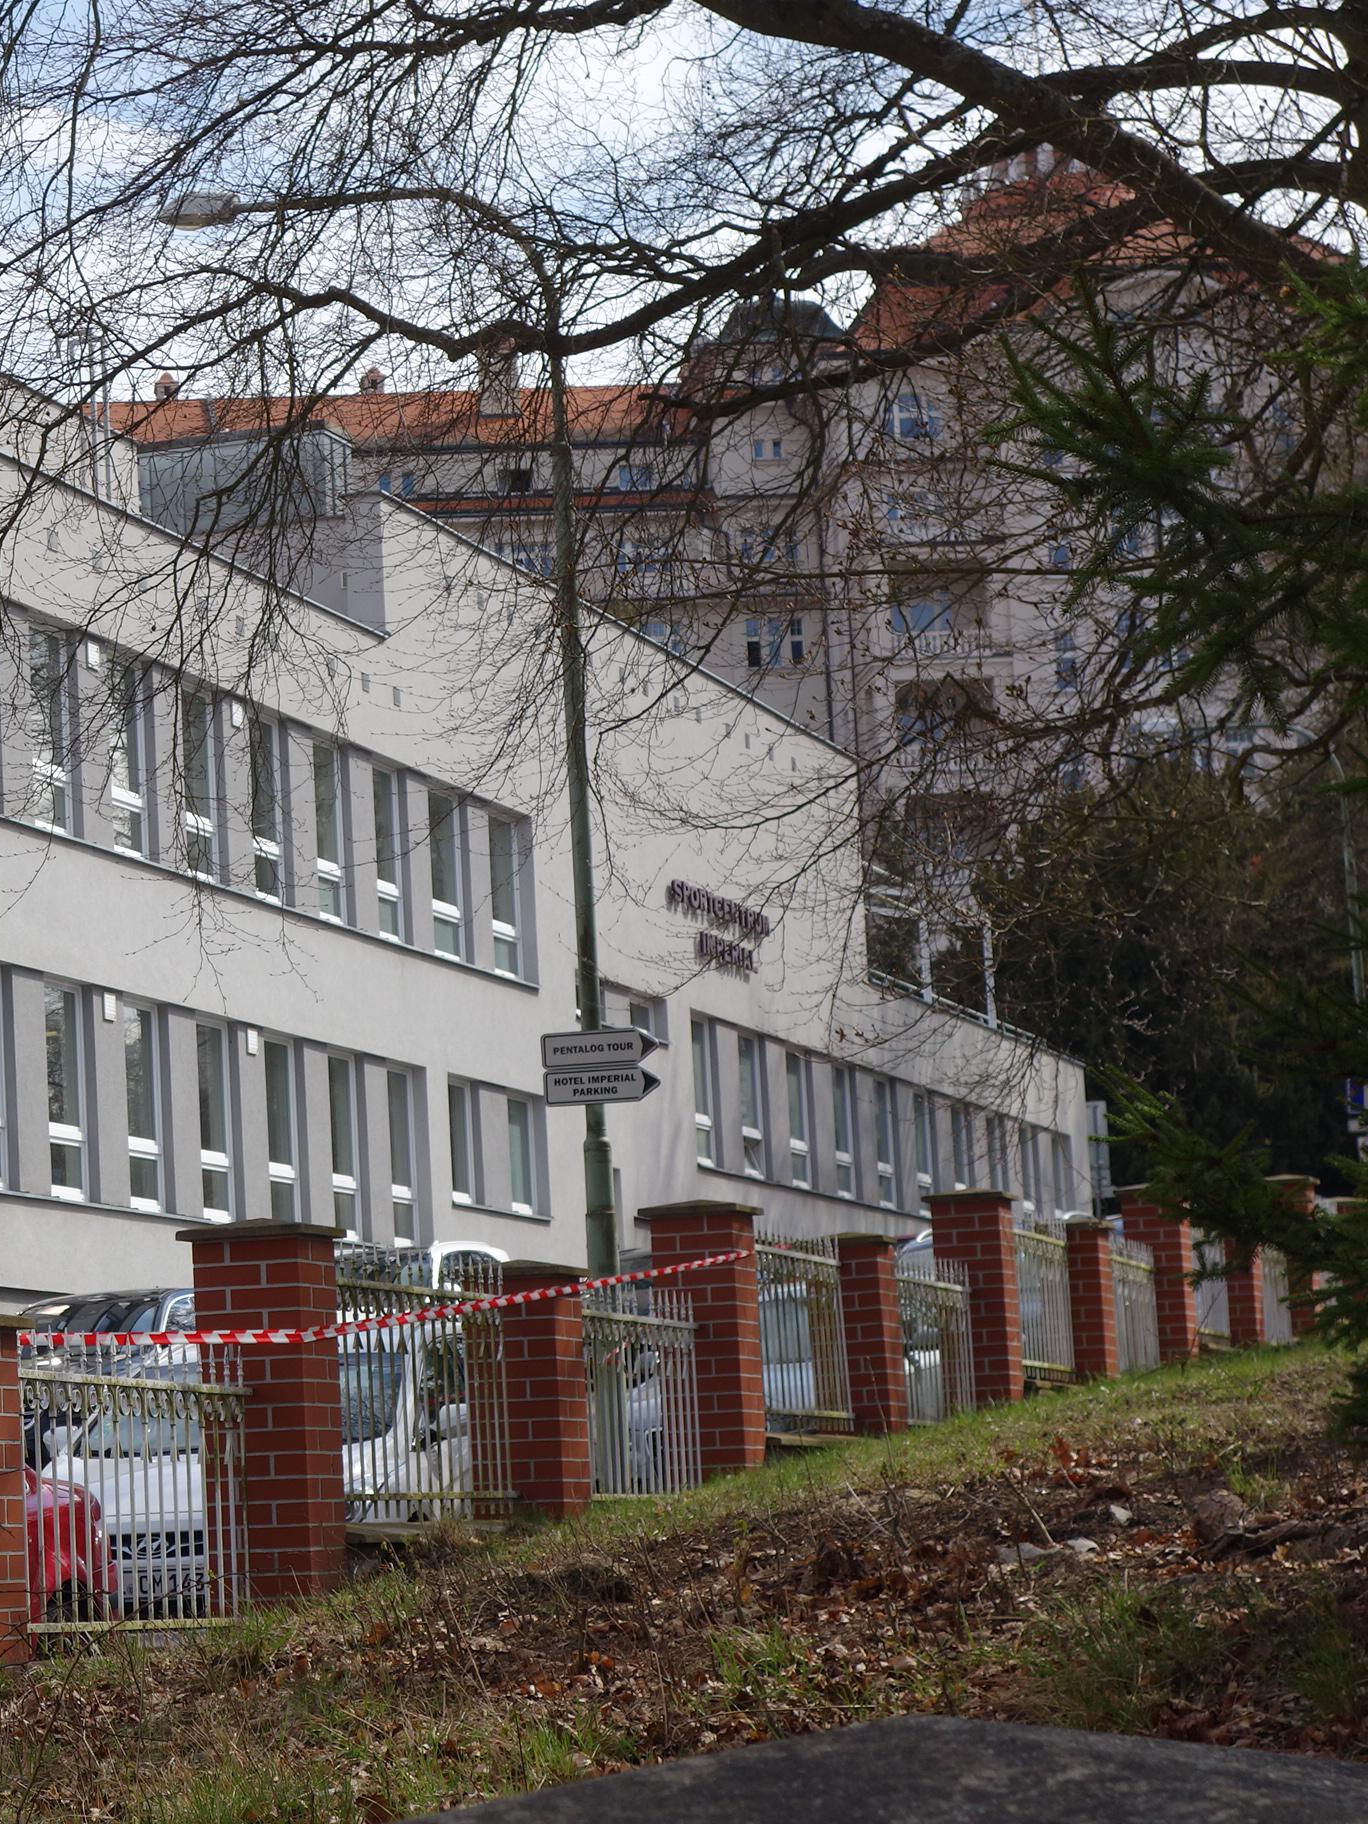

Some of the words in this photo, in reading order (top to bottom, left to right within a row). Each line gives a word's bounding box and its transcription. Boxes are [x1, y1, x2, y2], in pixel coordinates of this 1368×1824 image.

[670, 879, 770, 936] SPORTCENTRUM
[553, 1044, 604, 1055] PENTALOG
[606, 1041, 634, 1051] TOUR
[554, 1076, 585, 1086] HOTEL
[587, 1073, 637, 1084] IMPERIAL
[573, 1086, 618, 1097] PARKING
